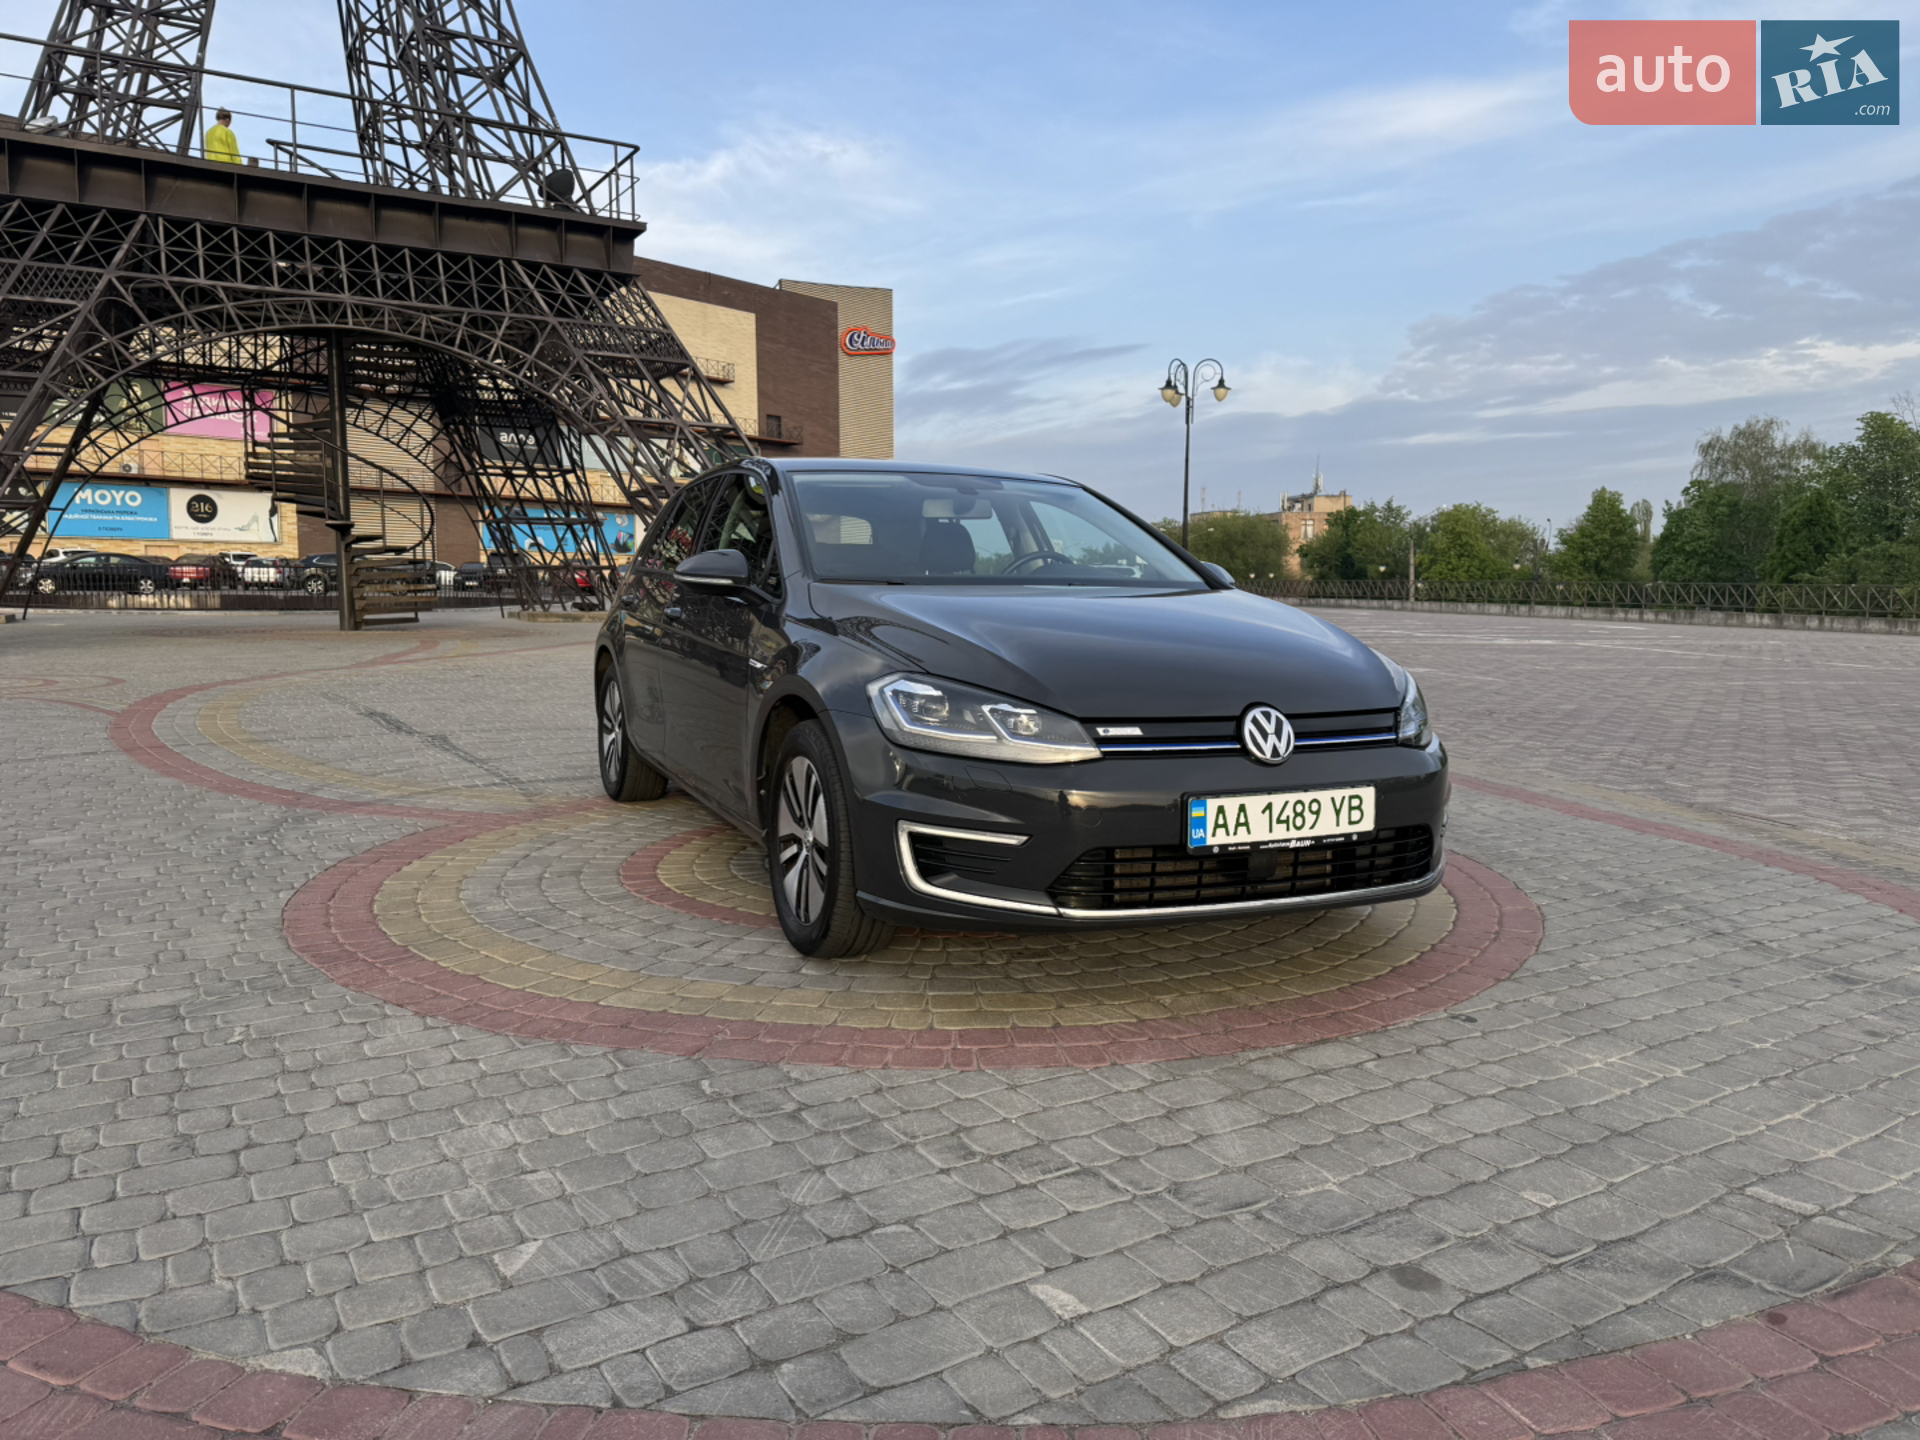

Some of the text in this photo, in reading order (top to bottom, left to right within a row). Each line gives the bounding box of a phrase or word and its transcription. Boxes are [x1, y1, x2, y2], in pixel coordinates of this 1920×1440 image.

[1211, 794, 1365, 837] AA 1489 YB
[1192, 828, 1206, 839] UA
